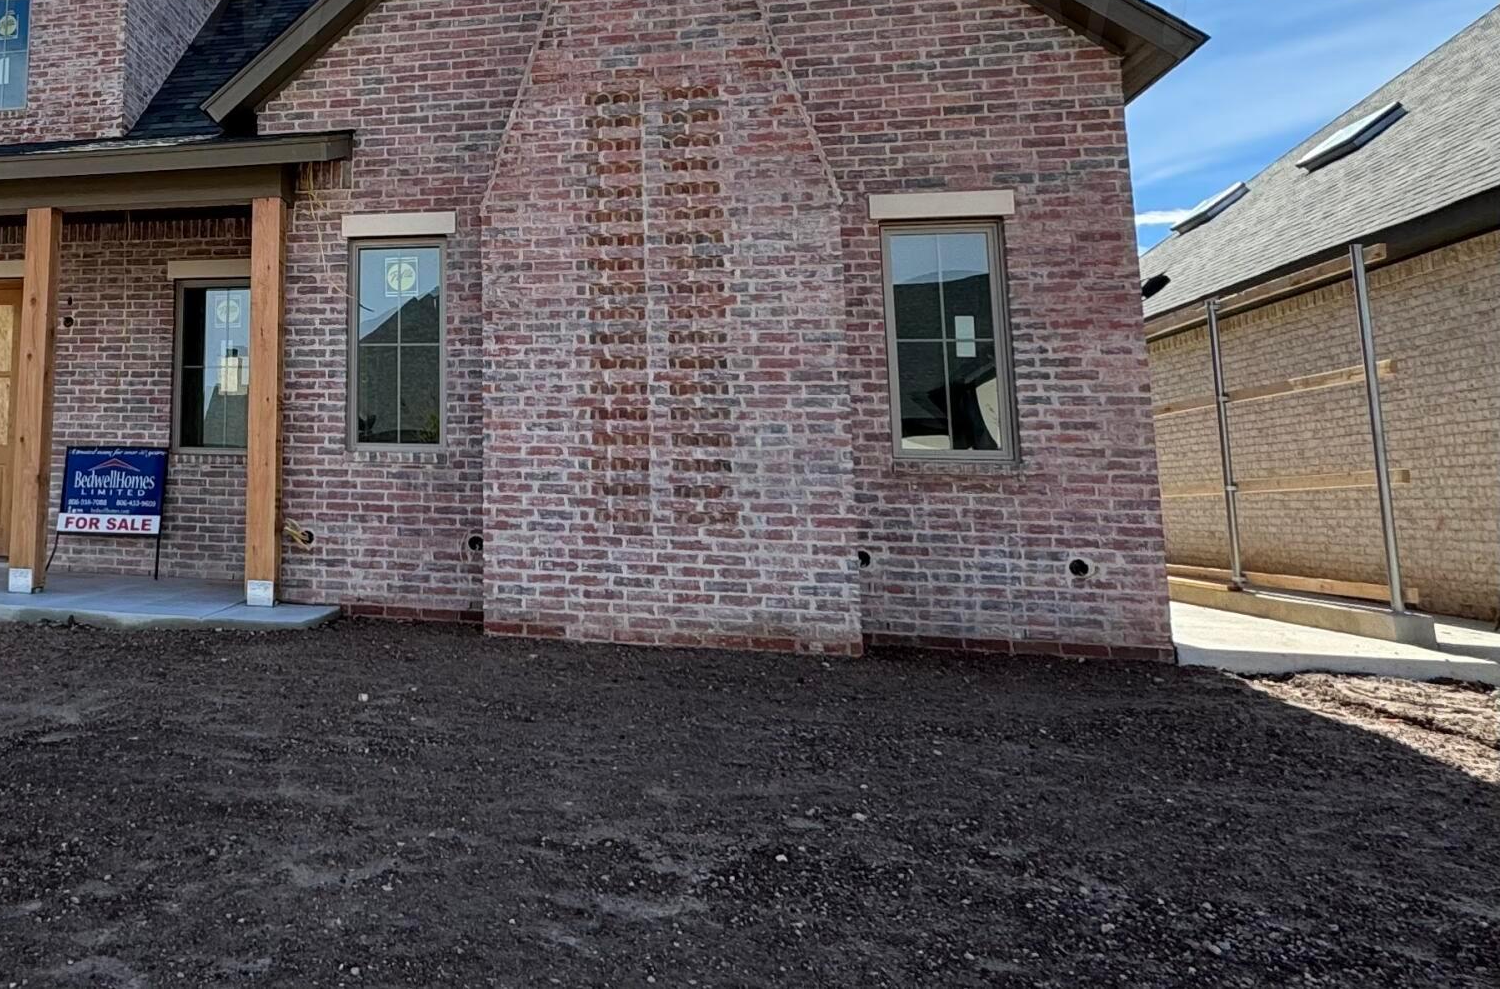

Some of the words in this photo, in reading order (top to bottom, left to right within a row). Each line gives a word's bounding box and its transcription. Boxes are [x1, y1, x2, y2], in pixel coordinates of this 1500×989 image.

[74, 470, 155, 489] BedwellHomes
[65, 517, 100, 529] FOR
[106, 518, 152, 531] SALE
